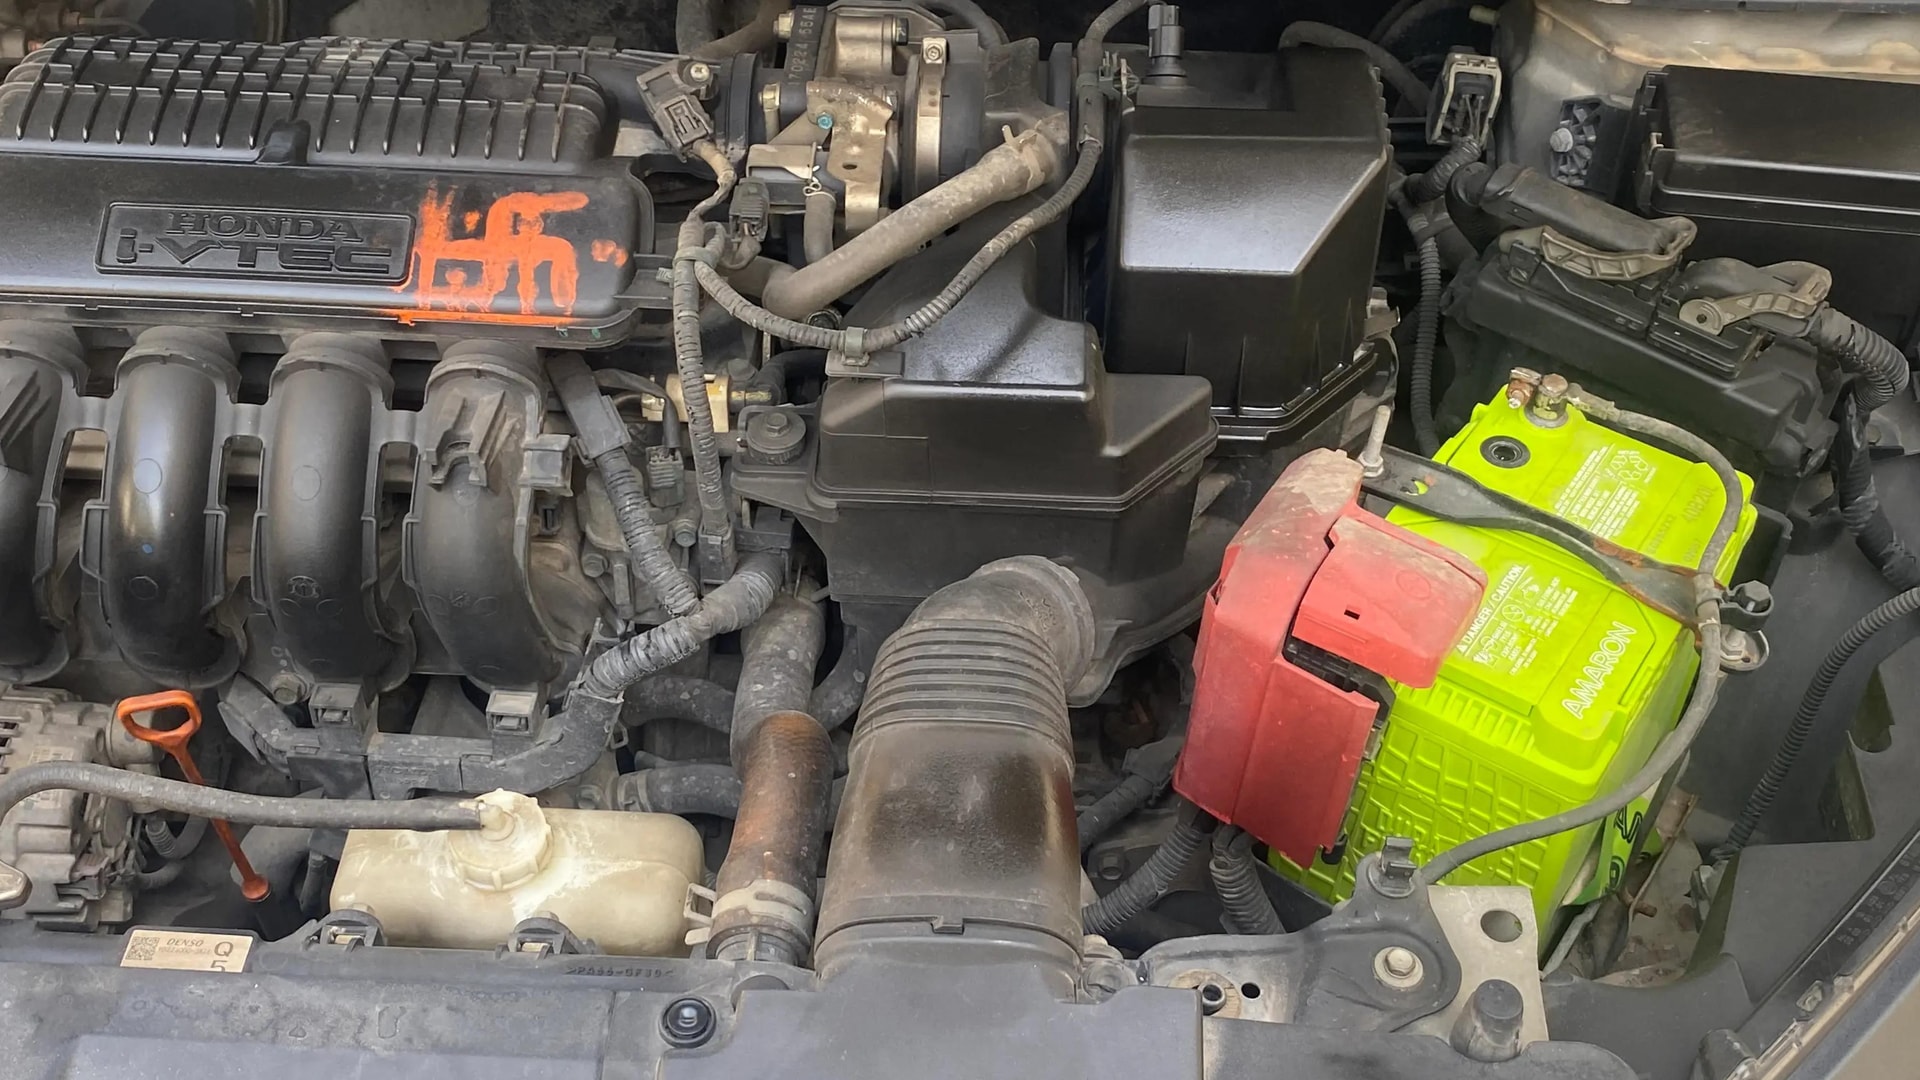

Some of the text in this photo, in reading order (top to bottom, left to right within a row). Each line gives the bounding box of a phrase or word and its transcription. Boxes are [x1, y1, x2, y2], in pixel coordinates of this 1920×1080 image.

[165, 211, 363, 242] HONDA
[116, 228, 392, 274] i-VTEC
[1467, 608, 1492, 644] DANGER
[1491, 564, 1524, 602] CAUTION
[1561, 620, 1637, 720] AMARON
[166, 937, 205, 948] DENSO
[214, 940, 234, 958] Q
